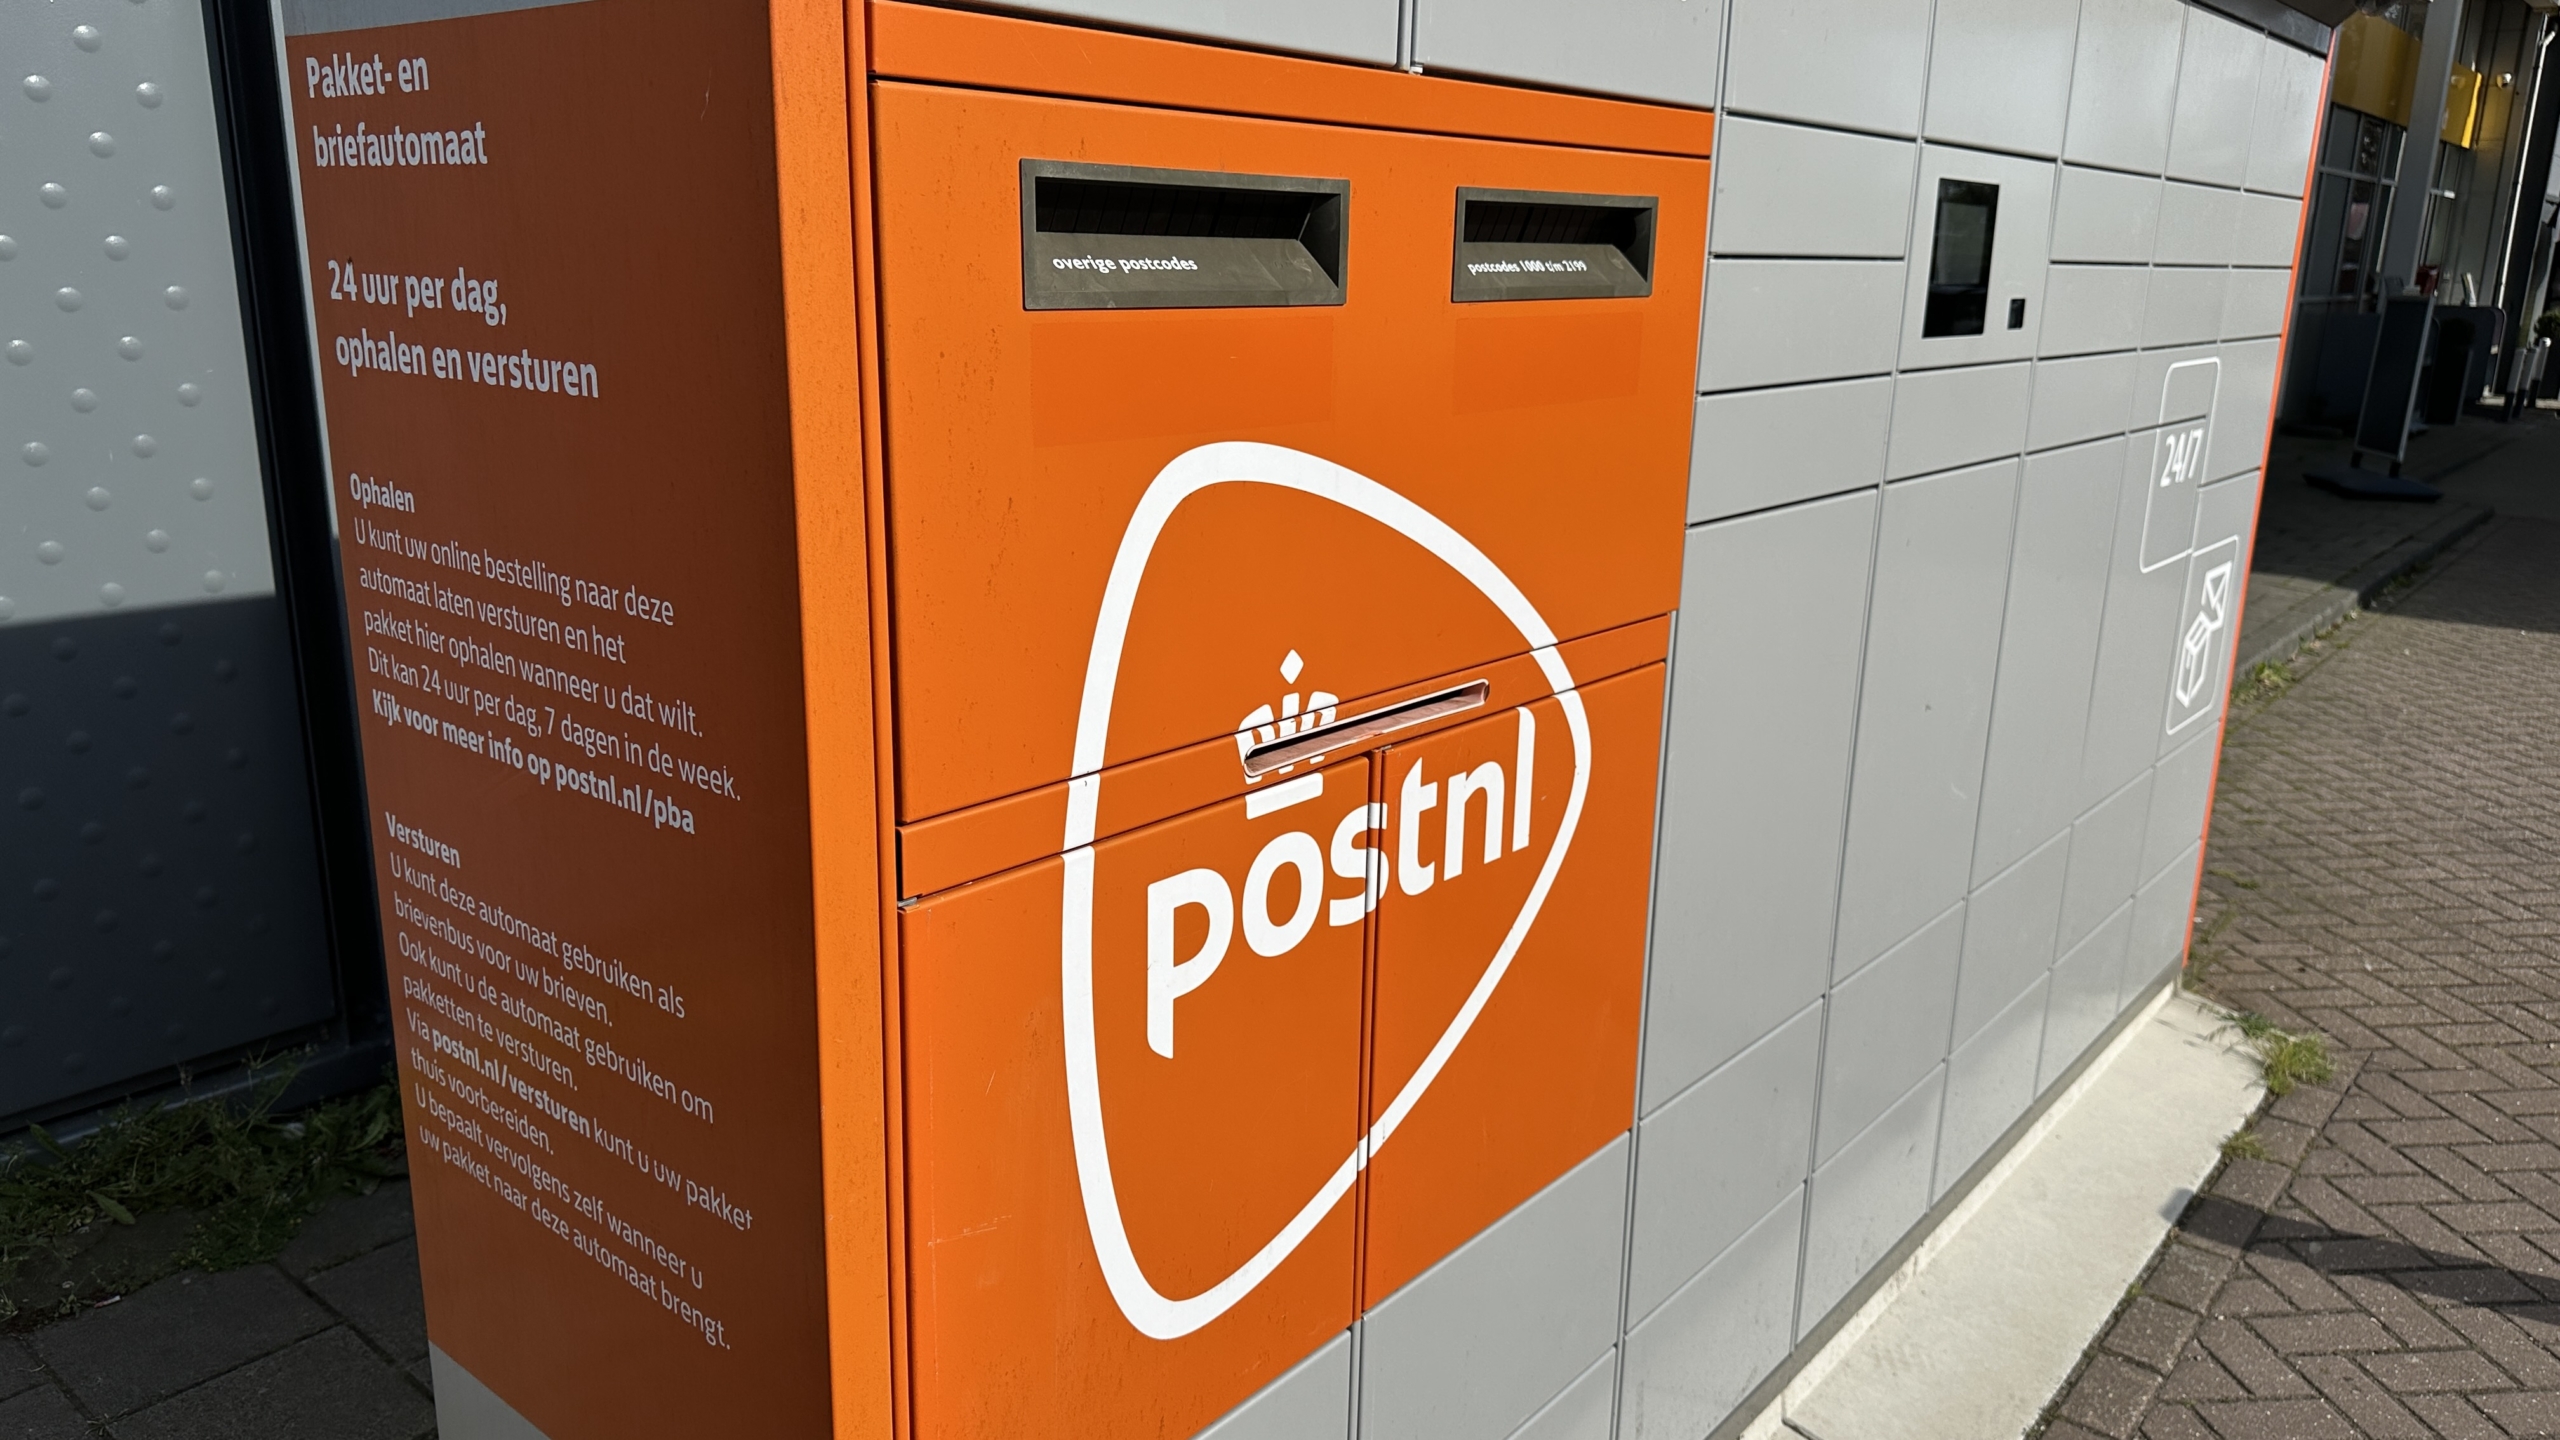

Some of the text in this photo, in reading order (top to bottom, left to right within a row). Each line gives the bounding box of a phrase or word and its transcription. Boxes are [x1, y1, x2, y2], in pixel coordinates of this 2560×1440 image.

[307, 53, 428, 97] Pakket- en
[314, 122, 487, 166] briefautomaat
[329, 261, 505, 325] 24 uur per dag,
[1053, 255, 1198, 274] overige postcodes
[1467, 260, 1588, 276] postcodes 1000 t/m 2199
[337, 329, 598, 397] ophalen en versturen
[351, 474, 414, 512] Ophalen
[2160, 427, 2204, 487] 24/7
[354, 517, 673, 625] U kunt uw online bestelling naar deze
[361, 568, 625, 663] automaat laten versturen en het
[365, 610, 701, 736] pakket hier ophalen wanneer u dat wilt.
[369, 648, 739, 800] Dit kan 24 uur per dag, 7 dagen in de week.
[373, 690, 694, 833] Kijk voor meer info op postnl.nl/pba
[386, 812, 459, 867] Versturen
[1147, 706, 1536, 1059] postnl
[390, 852, 684, 1017] U kunt deze automaat gebruiken als
[395, 892, 611, 1026] brievenbus voor uw brieven.
[400, 933, 712, 1122] Ook kunt u de automaat gebruiken om
[404, 977, 576, 1090] pakketten te versturen.
[407, 1009, 752, 1229] Via postnl.nl/versturen kunt u uw pakket
[412, 1049, 553, 1154] thuis voorbereiden.
[415, 1083, 702, 1289] U bepaalt vervolgens zelf wanneer u
[421, 1127, 729, 1349] uw pakket naar deze automaat brengt.
